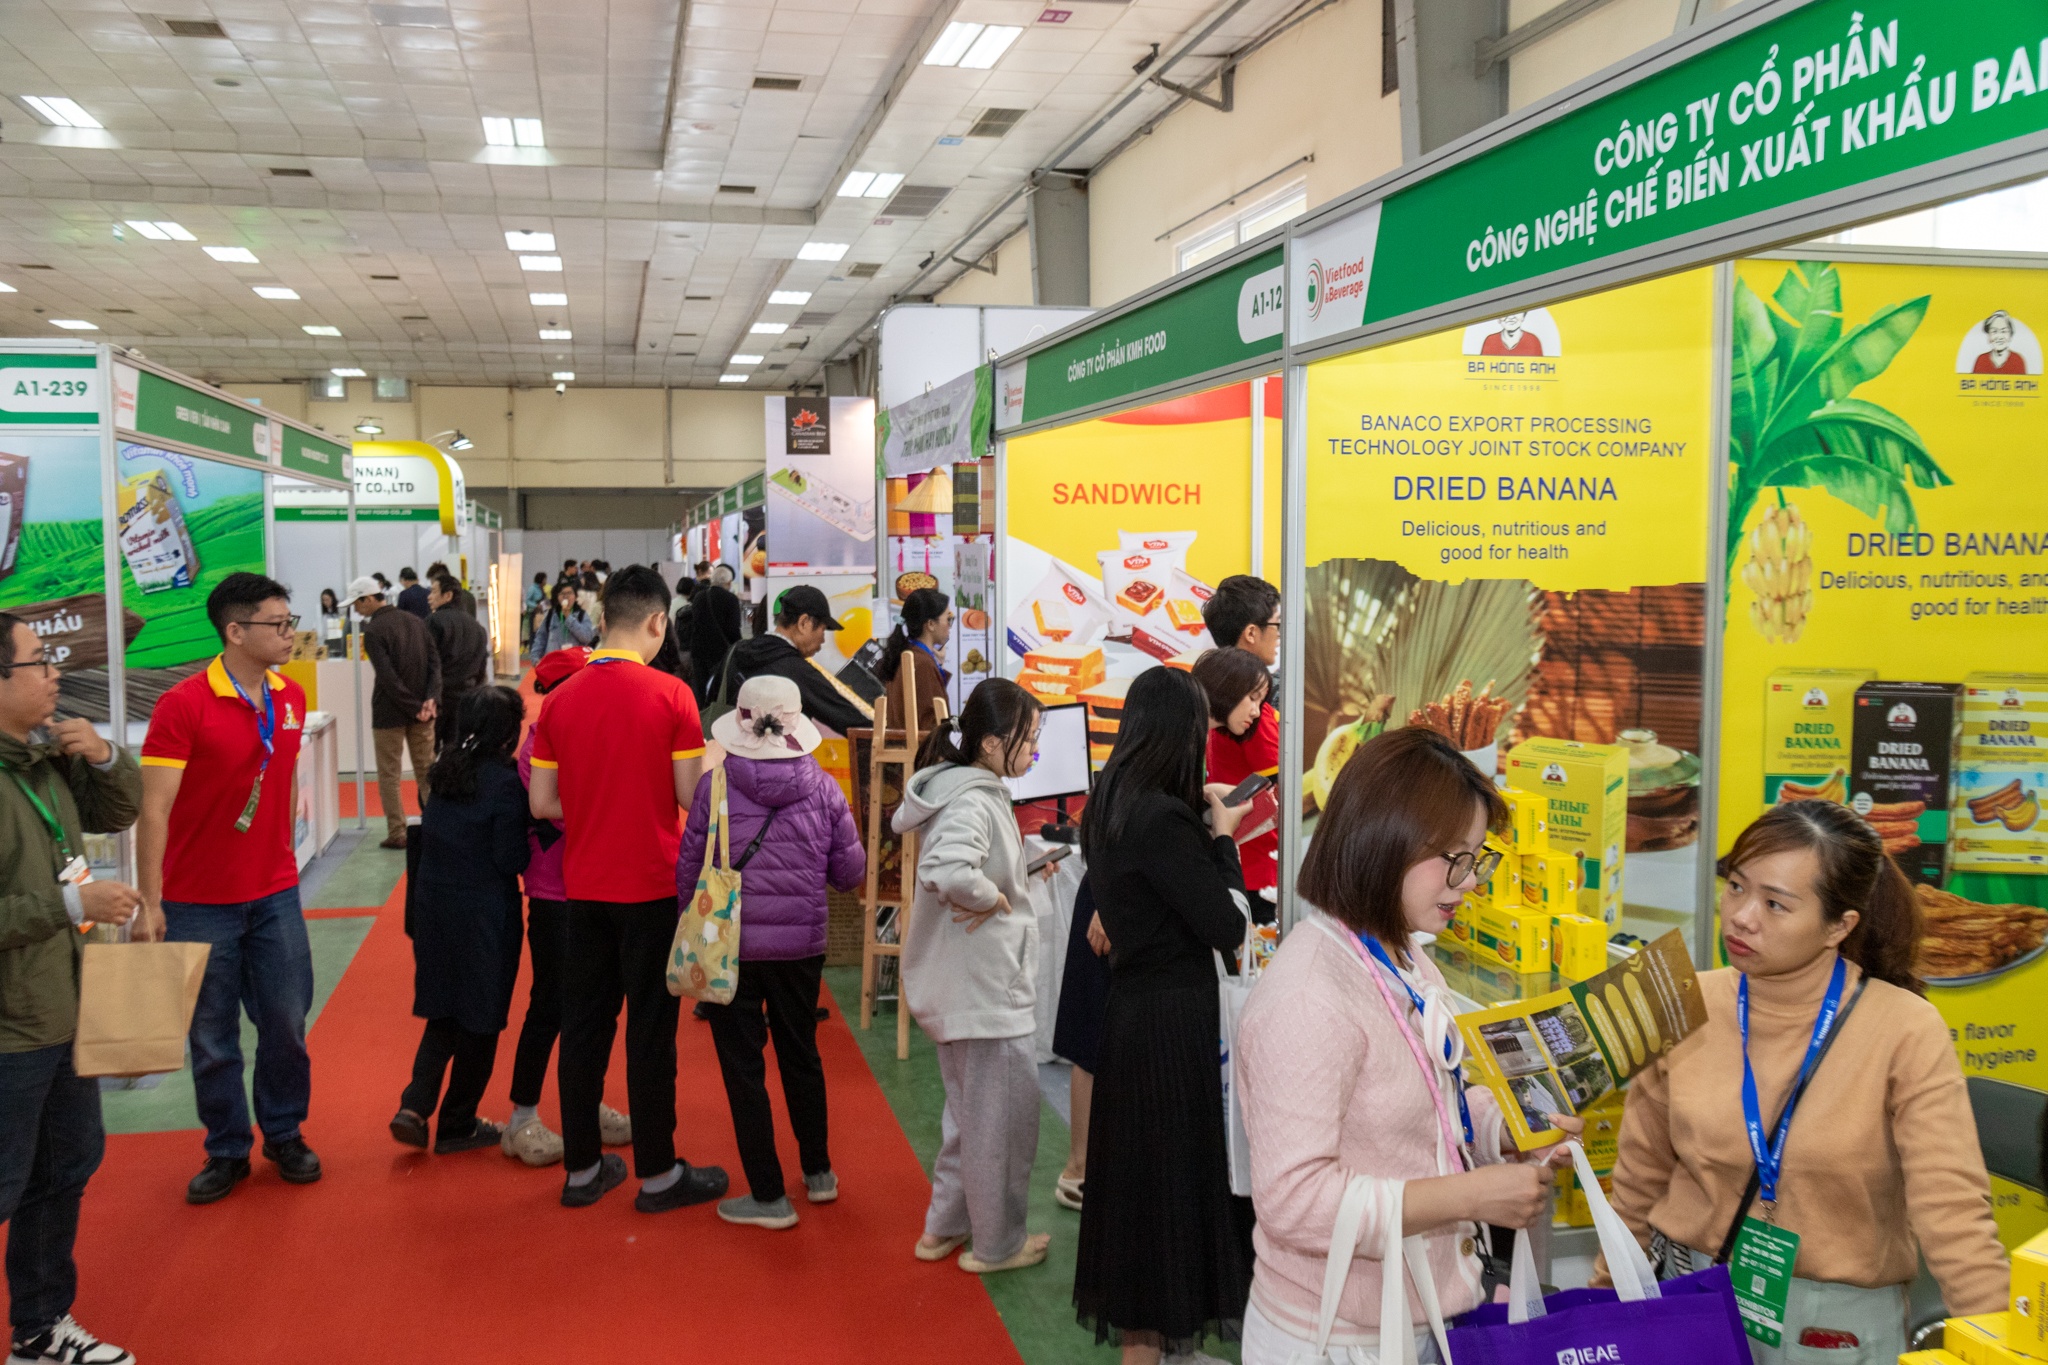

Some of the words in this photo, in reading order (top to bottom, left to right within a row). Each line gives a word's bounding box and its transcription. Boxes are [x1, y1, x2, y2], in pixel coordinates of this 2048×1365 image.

[1594, 112, 1679, 176] CÔNG
[1686, 92, 1720, 142] TY
[1728, 44, 1783, 125] CỔ
[1792, 11, 1898, 104] PHẦN
[1466, 224, 1528, 272] CÔNG
[1534, 188, 1598, 252] NGHỆ
[1604, 157, 1664, 228] CHẾ
[1666, 138, 1730, 210] BIẾN
[1739, 100, 1831, 187] XUẤT
[1841, 54, 1957, 155] KHẨU
[1325, 256, 1364, 284] Vietfood
[1068, 359, 1086, 382] CÔNG
[1086, 361, 1094, 375] TY
[1094, 343, 1106, 373] CỔ
[1106, 338, 1126, 369] PHẦN
[1126, 340, 1143, 362] KMH
[1144, 330, 1167, 357] FOOD
[13, 380, 88, 396] A1-239
[1361, 414, 1442, 432] BANACO
[1449, 415, 1523, 433] EXPORT
[1530, 416, 1652, 434] PROCESSING
[1328, 438, 1463, 456] TECHNOLOGY
[1469, 439, 1522, 457] JOINT
[1529, 440, 1591, 457] STOCK
[1597, 441, 1687, 458] COMPANY
[355, 467, 399, 478] NNAN)
[1052, 483, 1201, 506] SANDWICH
[1393, 476, 1486, 501] DRIED
[1499, 476, 1618, 501] BANANA
[1402, 520, 1485, 538] Delicious,
[1492, 521, 1570, 536] nutritious
[1576, 521, 1606, 536] and
[1440, 545, 1482, 564] good
[1489, 544, 1512, 560] for
[1518, 544, 1568, 560] health
[1848, 532, 1934, 557] DRIED
[1127, 558, 1149, 566] VTM
[1821, 571, 1913, 591] Delicious,
[1920, 570, 2013, 590] nutritious,
[1911, 598, 1958, 621] good
[1965, 597, 1990, 615] for
[42, 643, 72, 664] ẤP
[1794, 723, 1835, 735] DRIED
[1988, 719, 2030, 732] DRIED
[1785, 737, 1841, 749] BANANA
[1877, 741, 1923, 755] DRIED
[1979, 733, 2036, 746] BANANA
[1868, 756, 1931, 771] BANANA
[1548, 798, 1590, 815] ЕНЫЕ
[1964, 1022, 2016, 1041] flavor
[1965, 1048, 2037, 1070] hygiene
[1577, 1343, 1621, 1365] IEAE
